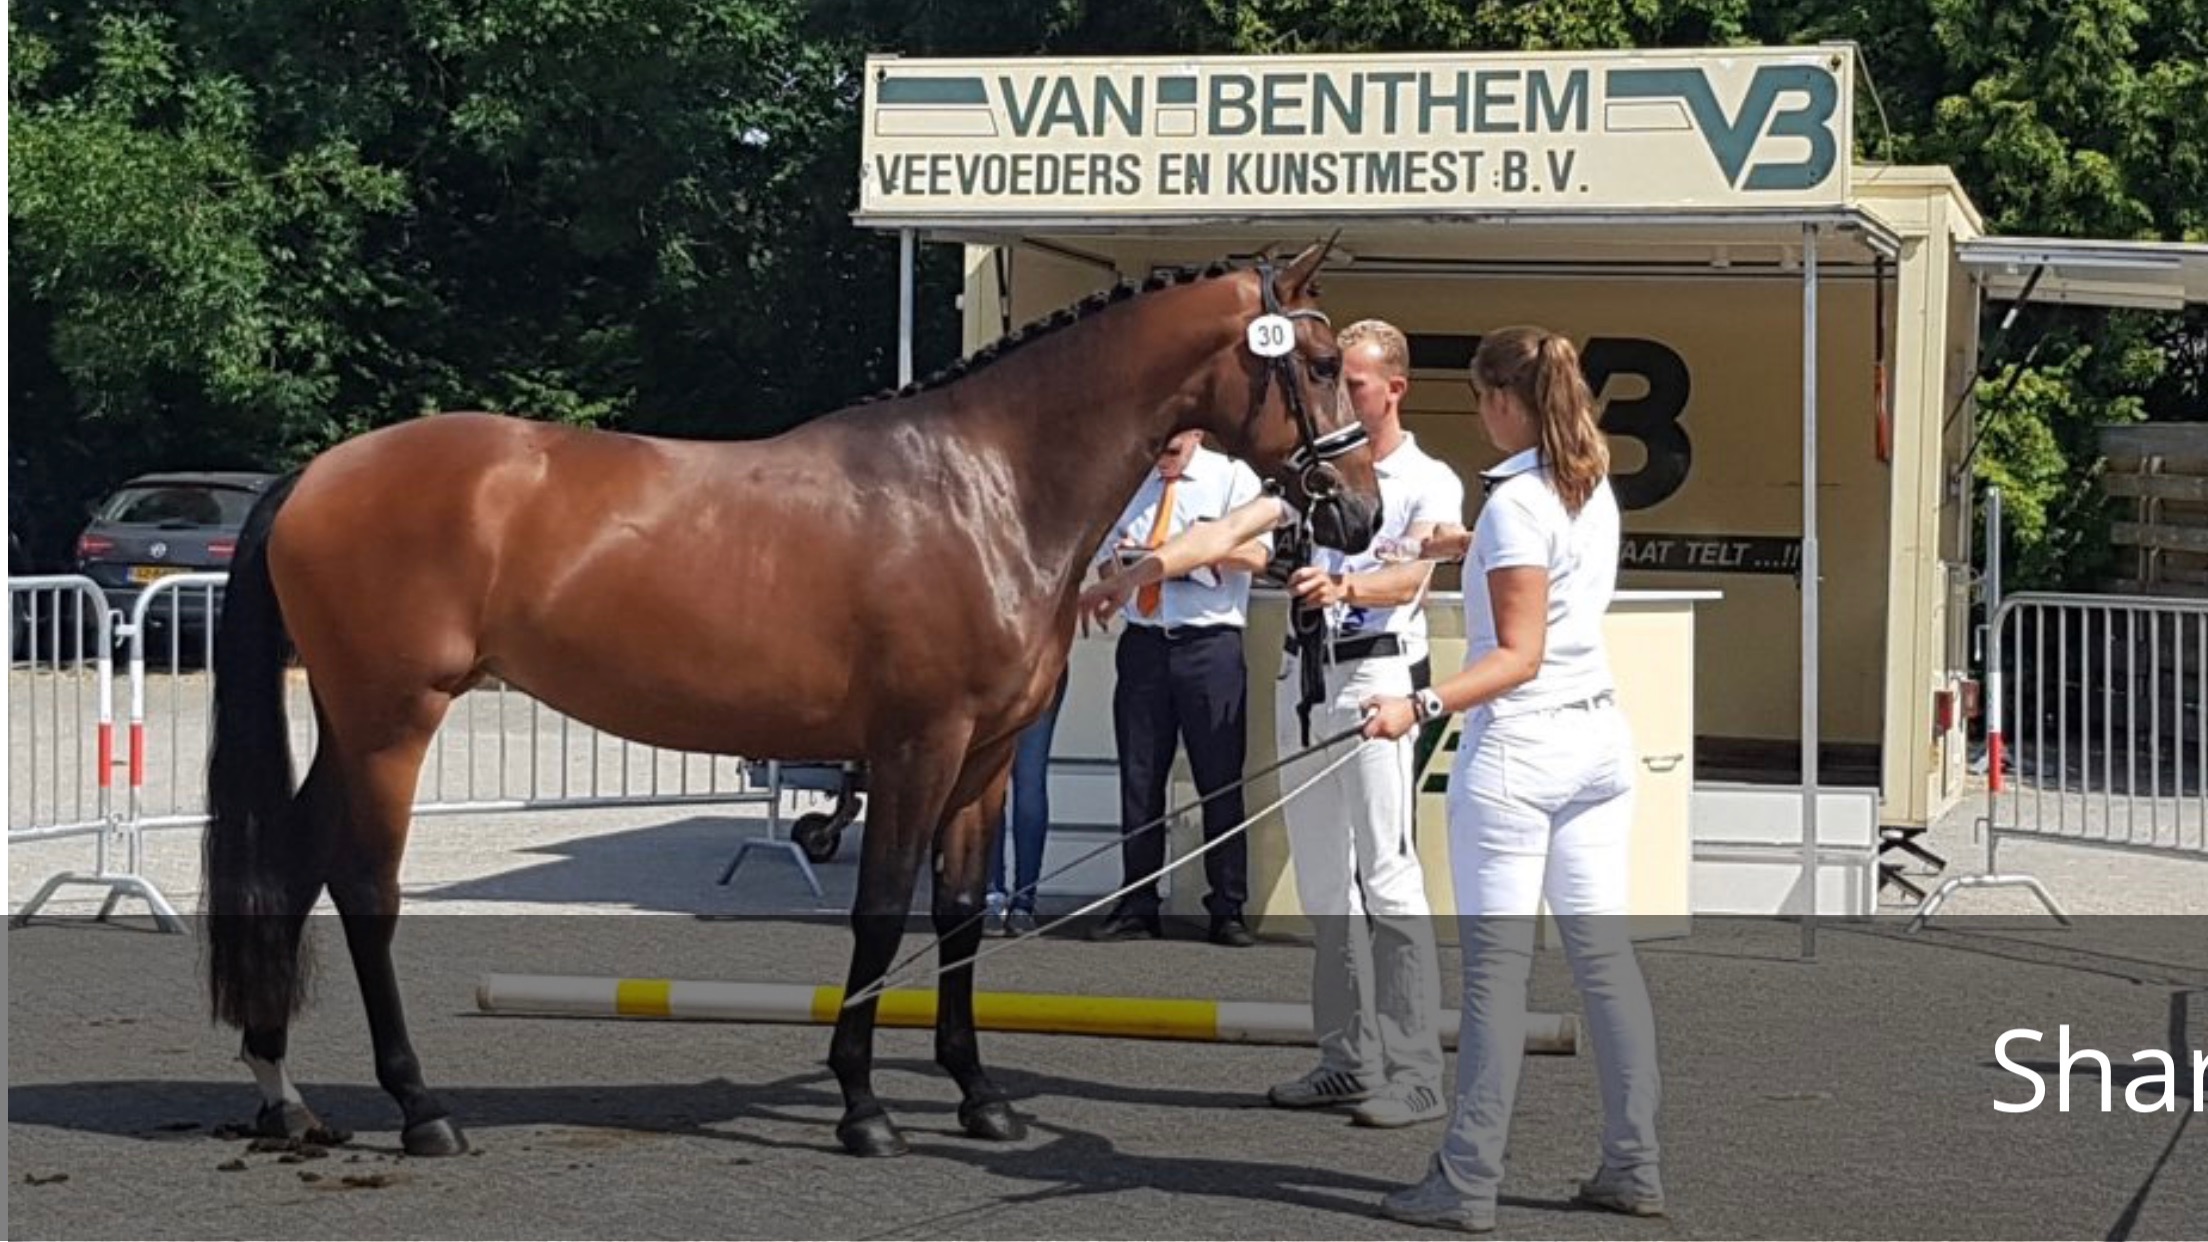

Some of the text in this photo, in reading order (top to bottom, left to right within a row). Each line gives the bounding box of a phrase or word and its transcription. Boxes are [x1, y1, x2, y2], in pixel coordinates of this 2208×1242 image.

[998, 69, 1589, 137] VAN BENTHEM
[876, 152, 1142, 196] VEEVOEDERS
[1158, 152, 1210, 196] EN
[1226, 150, 1484, 195] KUNSTMEST
[1257, 324, 1285, 347] 30
[1686, 541, 1751, 566] TELT
